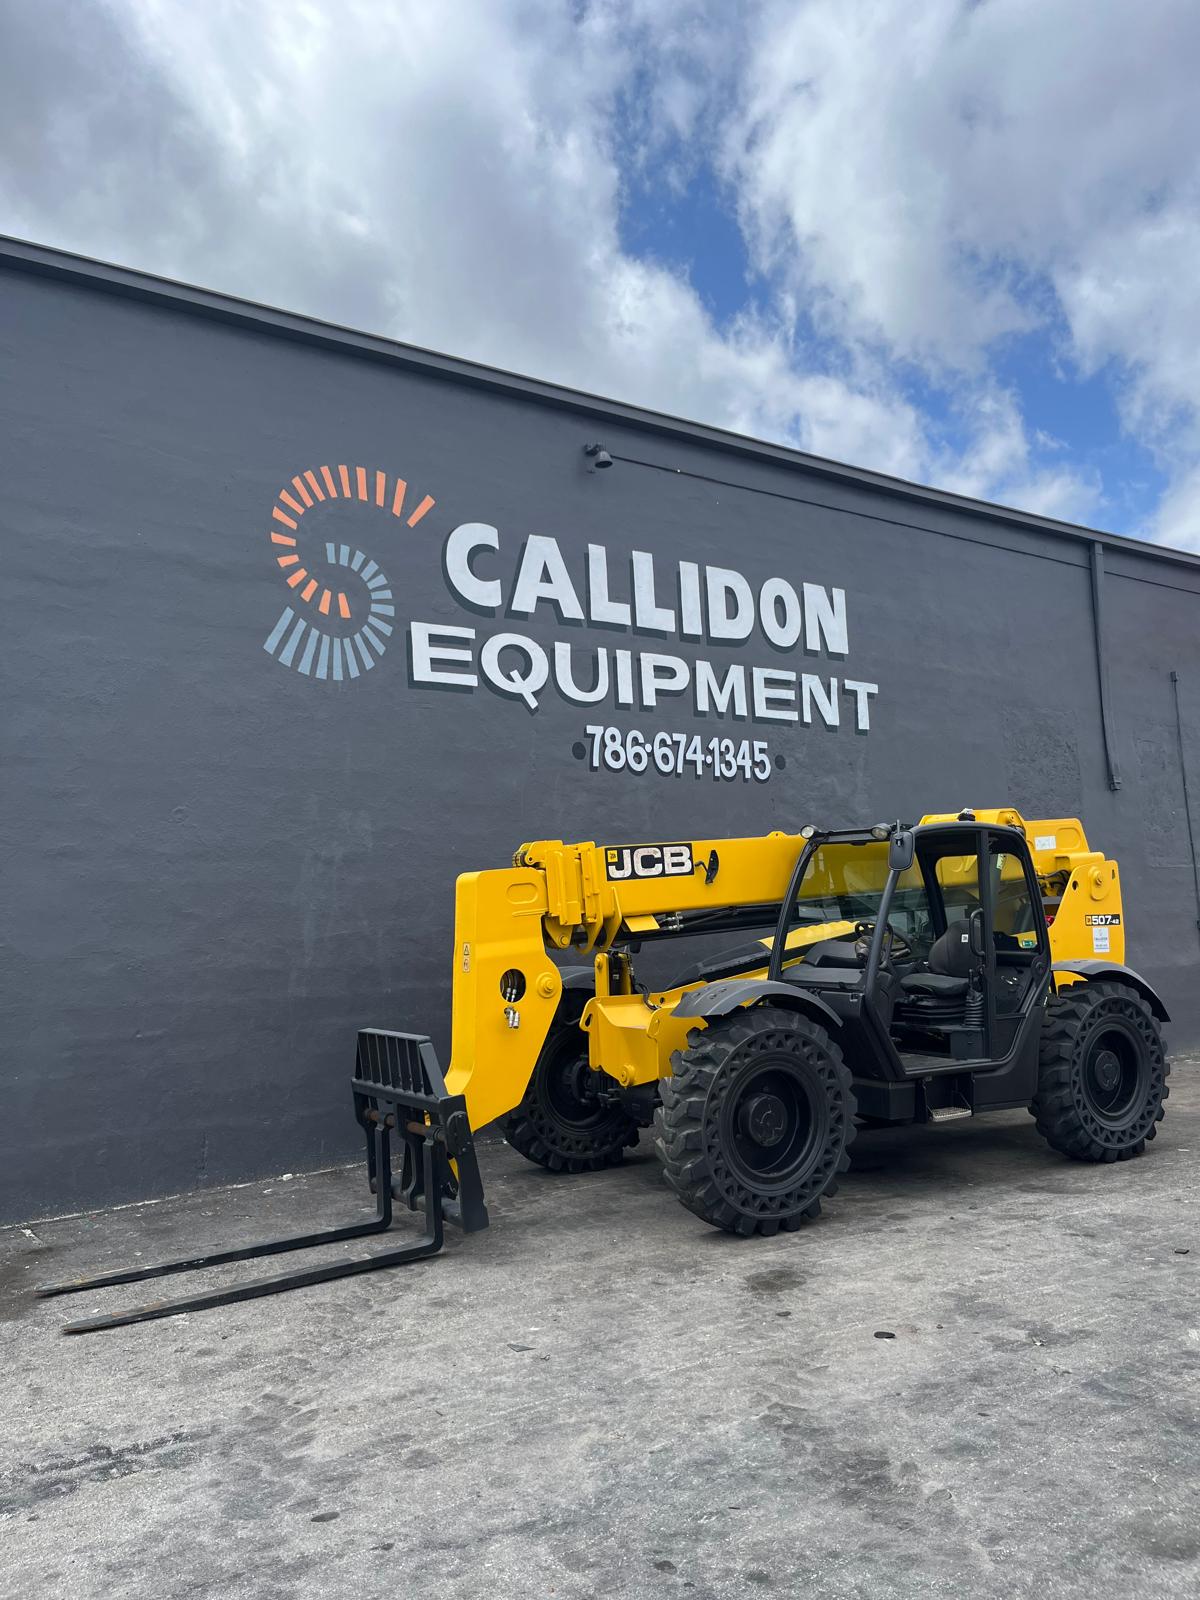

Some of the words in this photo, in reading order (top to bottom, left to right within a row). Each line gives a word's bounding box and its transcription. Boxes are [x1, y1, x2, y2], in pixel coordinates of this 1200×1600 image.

[445, 522, 849, 655] CALLIDON
[410, 621, 879, 731] EQUIPMENT
[608, 845, 692, 878] JCB
